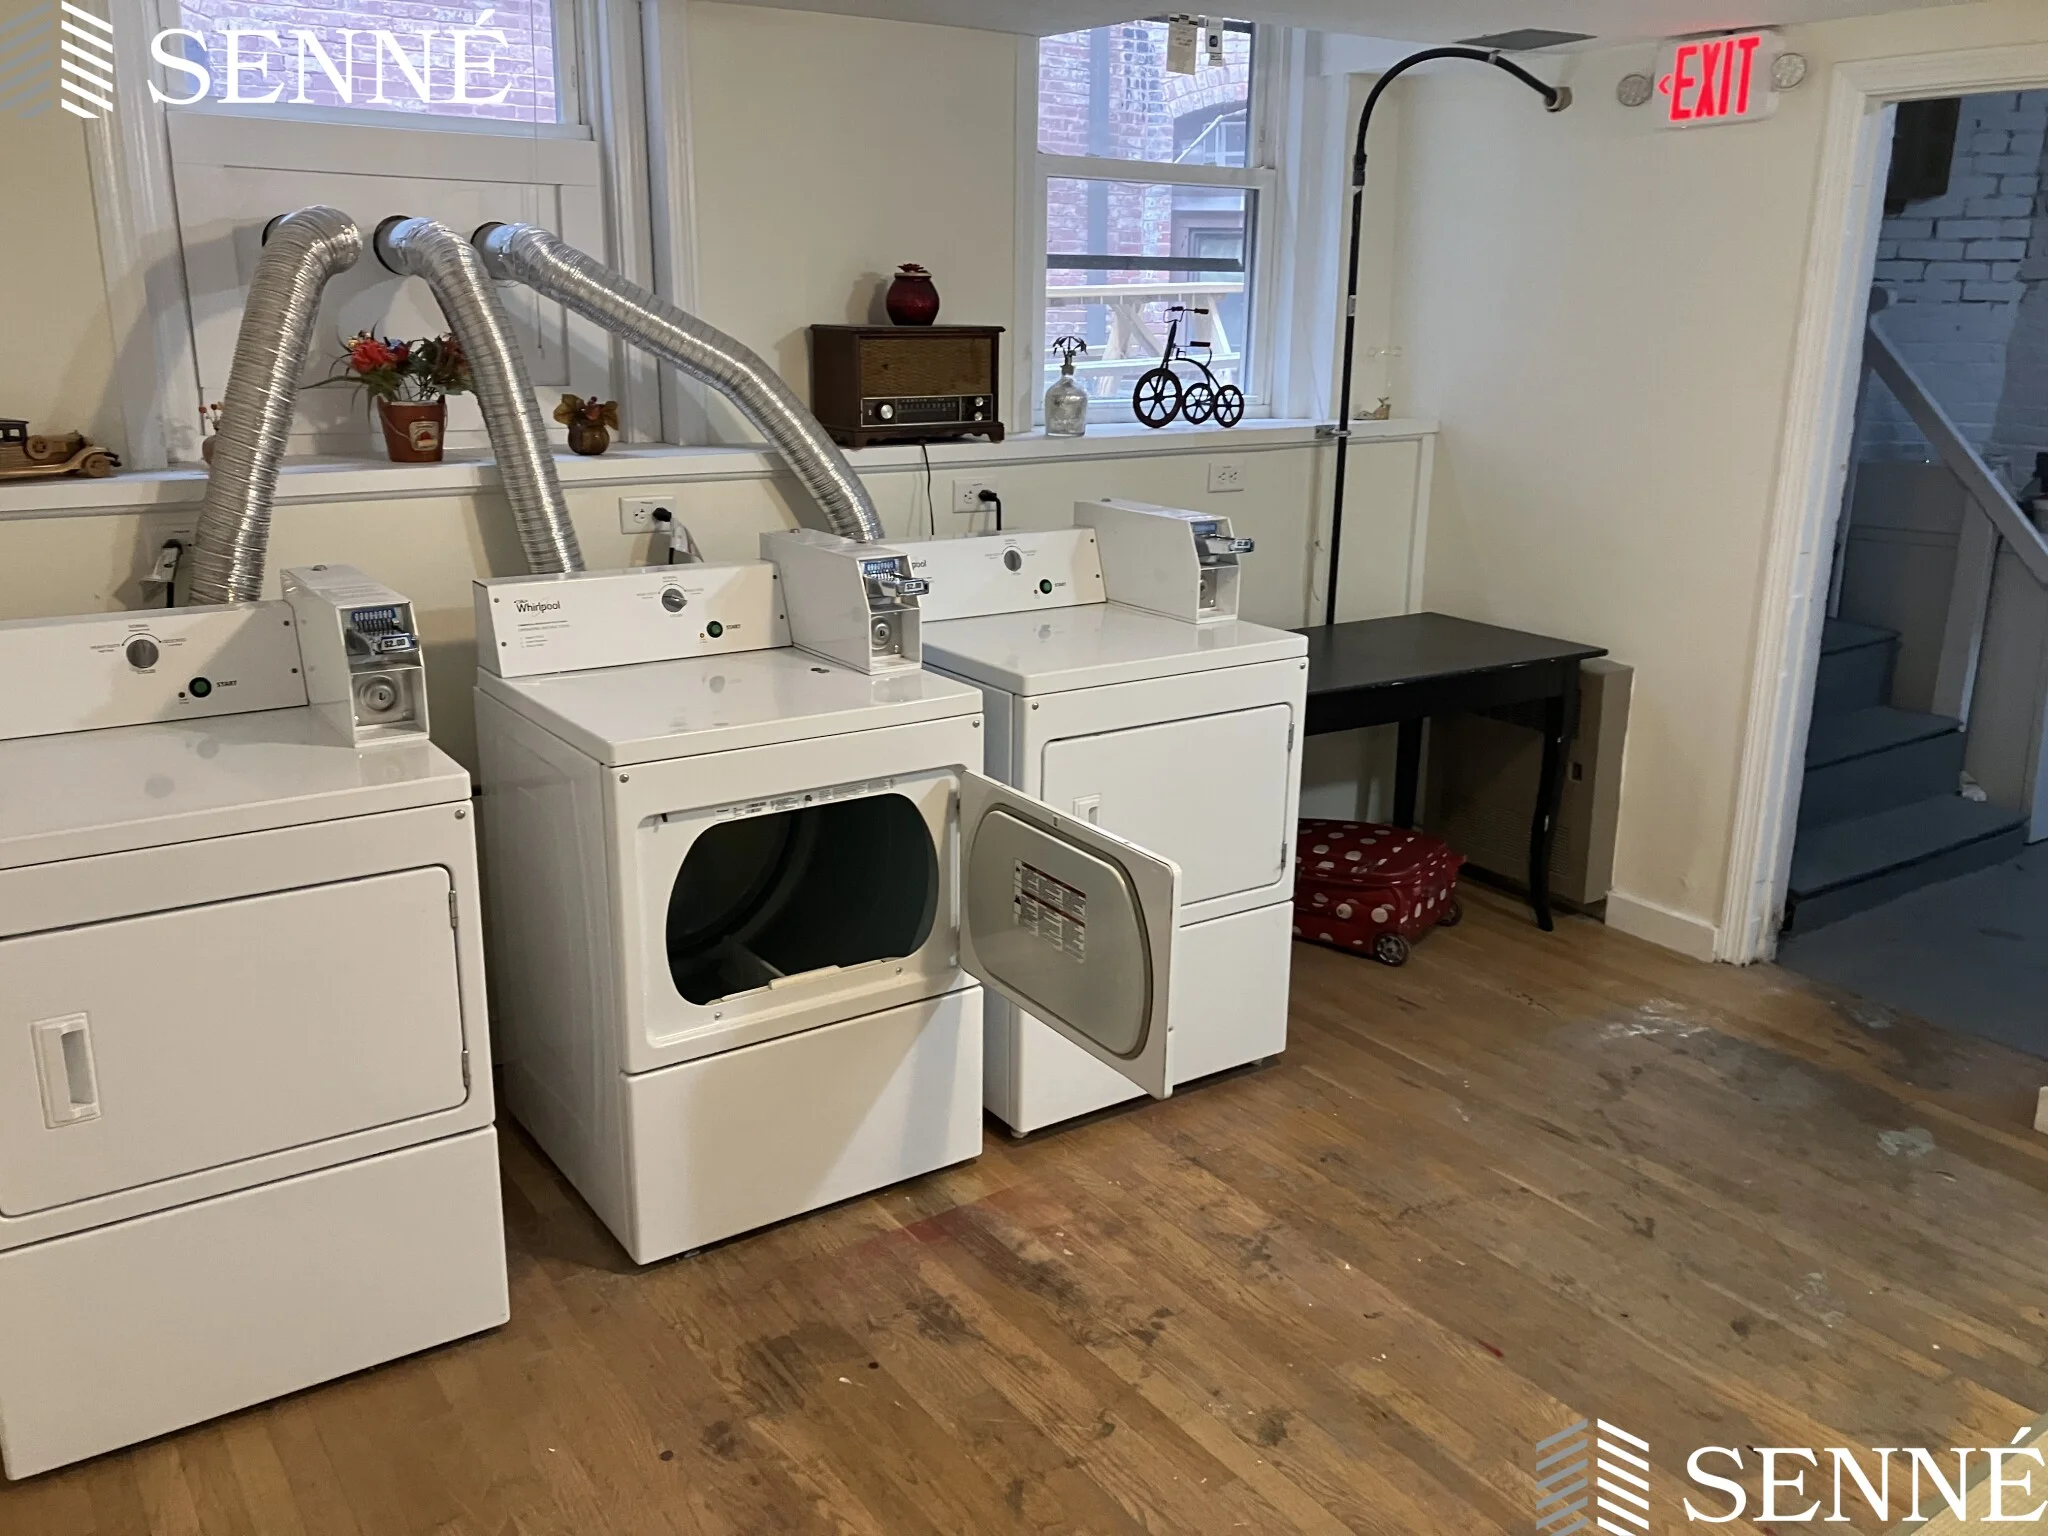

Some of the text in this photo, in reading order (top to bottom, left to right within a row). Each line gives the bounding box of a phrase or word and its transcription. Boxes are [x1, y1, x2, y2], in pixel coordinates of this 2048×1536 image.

[1669, 36, 1761, 121] EXIT
[516, 601, 561, 613] Whirlpool
[216, 680, 238, 688] START
